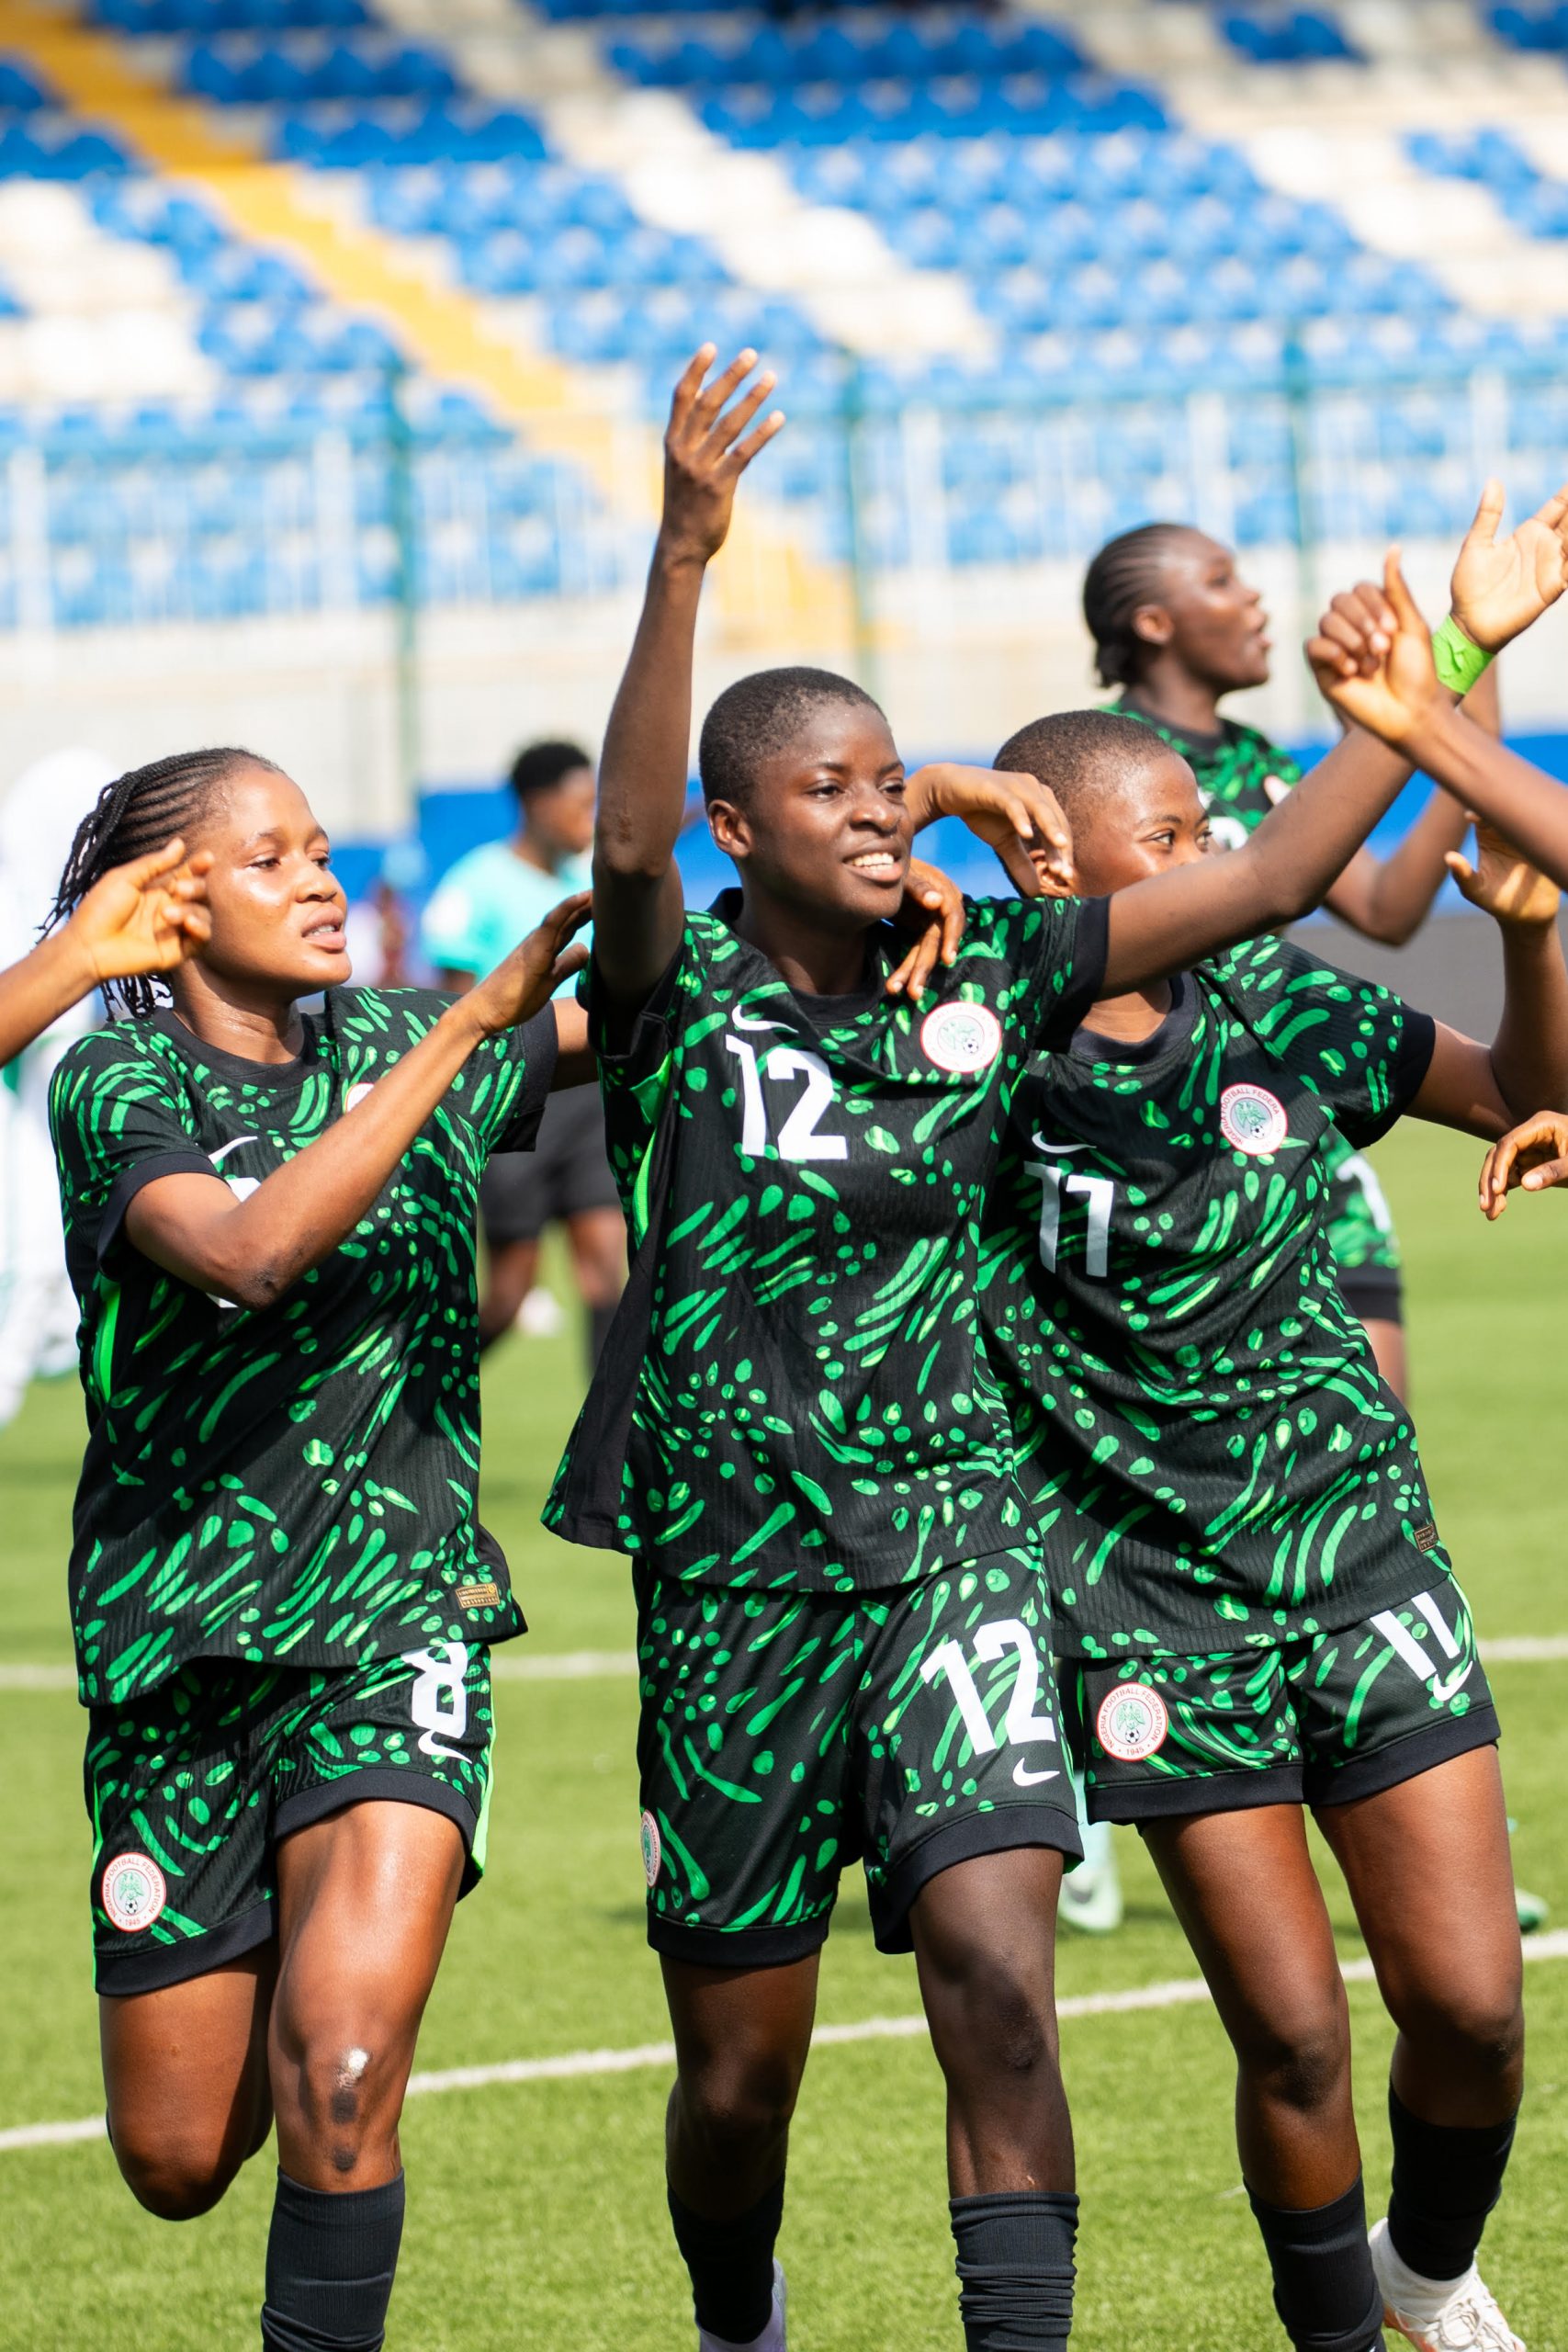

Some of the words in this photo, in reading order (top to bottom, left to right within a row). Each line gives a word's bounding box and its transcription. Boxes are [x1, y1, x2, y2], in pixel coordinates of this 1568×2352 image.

[726, 1035, 848, 1159] 12
[1023, 1160, 1114, 1277] 11
[400, 1642, 468, 1739] 8
[919, 1619, 1056, 1756] 12
[1103, 1688, 1139, 1713] FOOTBALL
[1100, 1714, 1114, 1748] NIGERIA
[1142, 1690, 1163, 1742] FEDERATION
[1126, 1747, 1145, 1756] 1945
[107, 1858, 140, 1881] FOOTBALL
[141, 1862, 161, 1914] FEDERATION
[105, 1883, 117, 1917] NIGERIA
